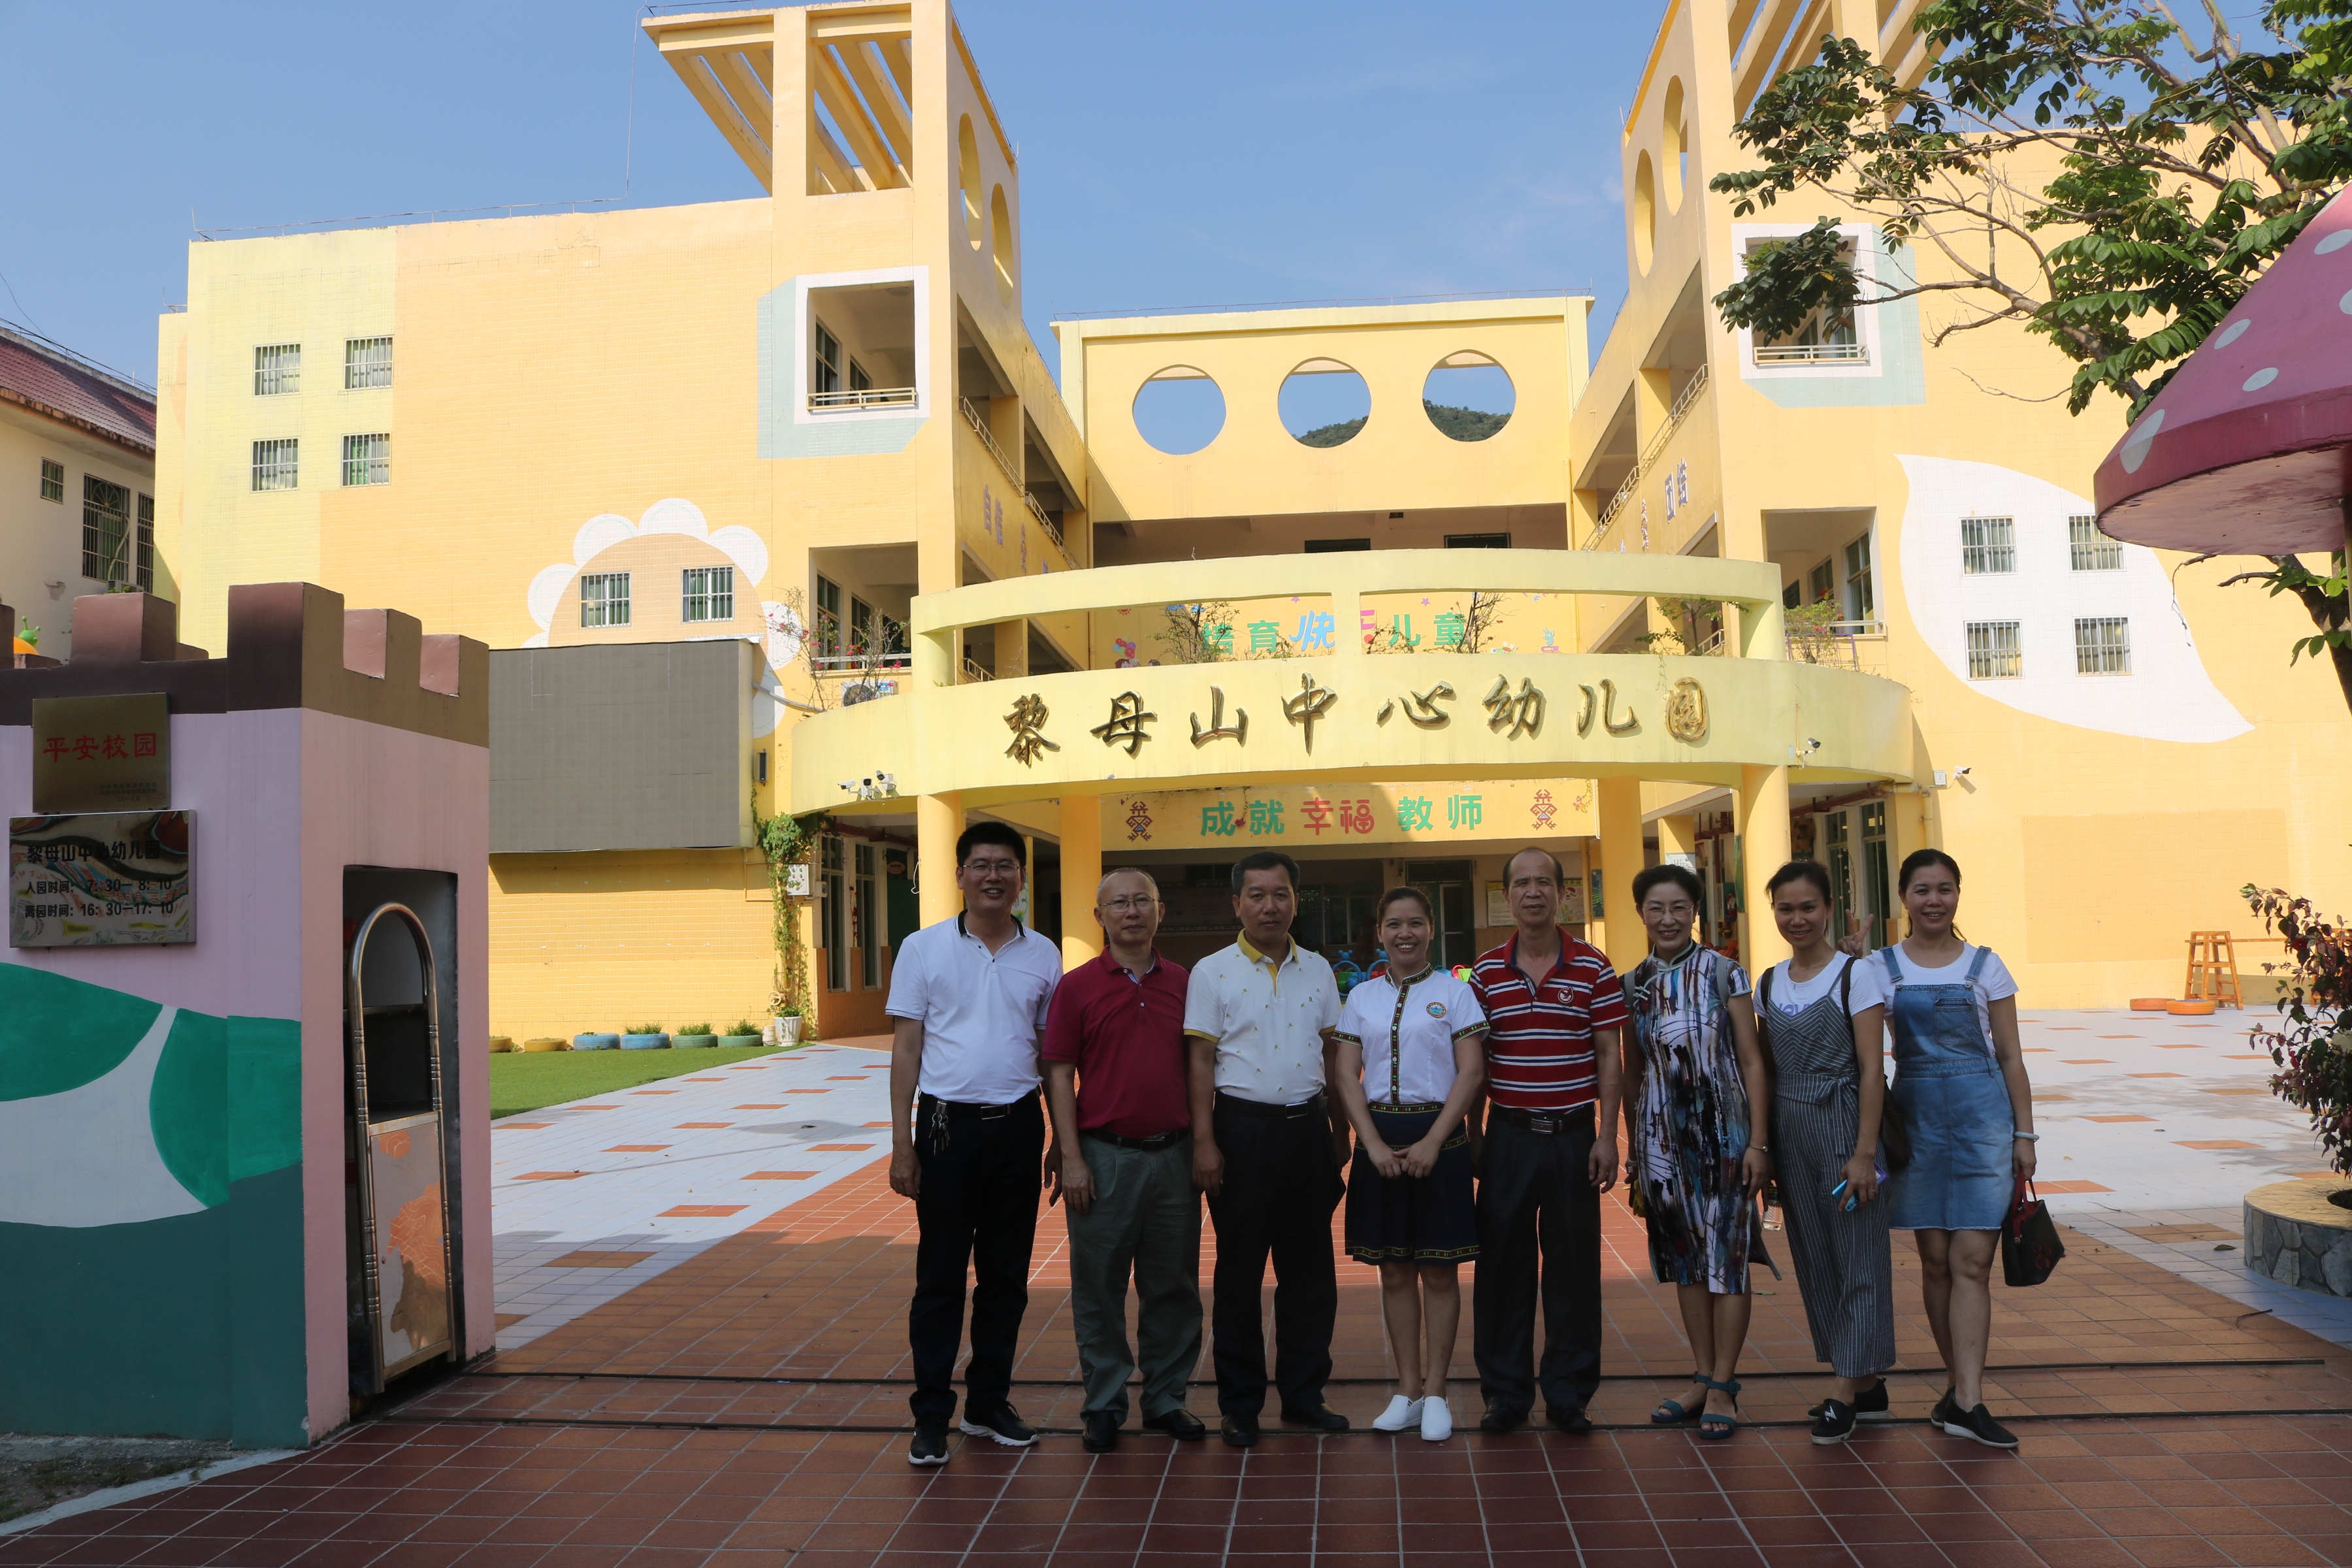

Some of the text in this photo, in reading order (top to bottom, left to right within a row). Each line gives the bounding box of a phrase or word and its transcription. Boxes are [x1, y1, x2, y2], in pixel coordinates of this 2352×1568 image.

[1003, 672, 1708, 766] 黎母山中心幼儿园
[43, 732, 157, 763] 平安校园
[1200, 794, 1482, 836] 成就幸福教师
[27, 840, 160, 863] 黎母山中心幼儿园
